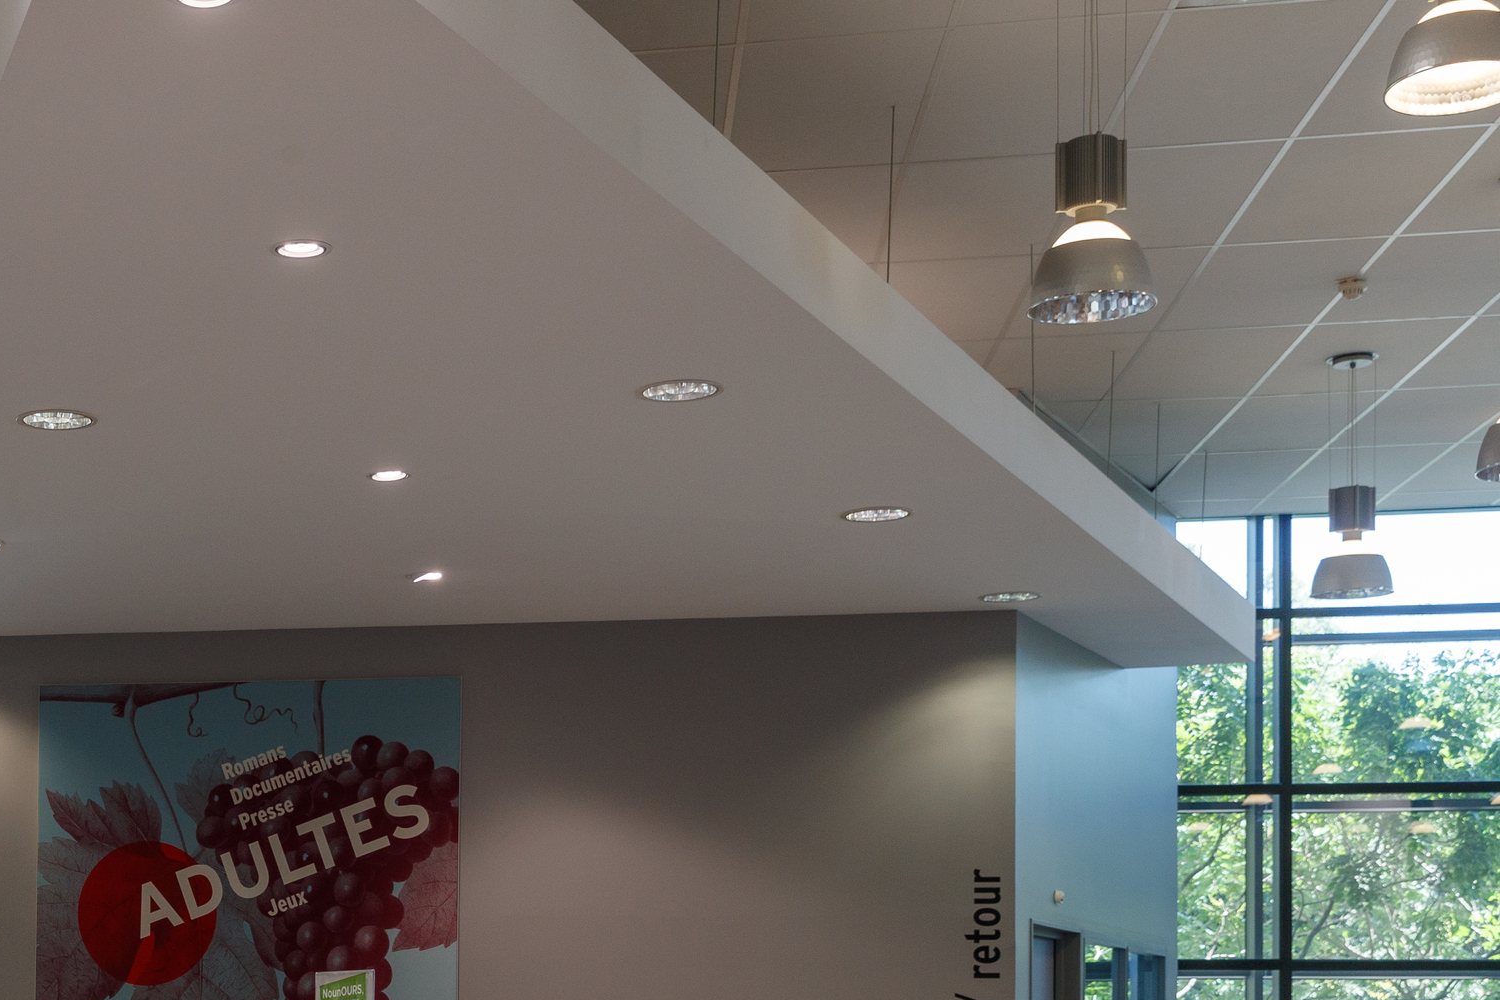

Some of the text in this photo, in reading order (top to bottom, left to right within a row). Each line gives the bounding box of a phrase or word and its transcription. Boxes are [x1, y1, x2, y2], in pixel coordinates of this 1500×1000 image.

[221, 745, 287, 780] Romans
[229, 748, 352, 805] Documentaires
[238, 799, 295, 831] Presse
[140, 784, 430, 939] ADULTES
[267, 890, 308, 917] Jeux
[964, 868, 1002, 979] retour
[322, 983, 365, 999] NounOURS,
